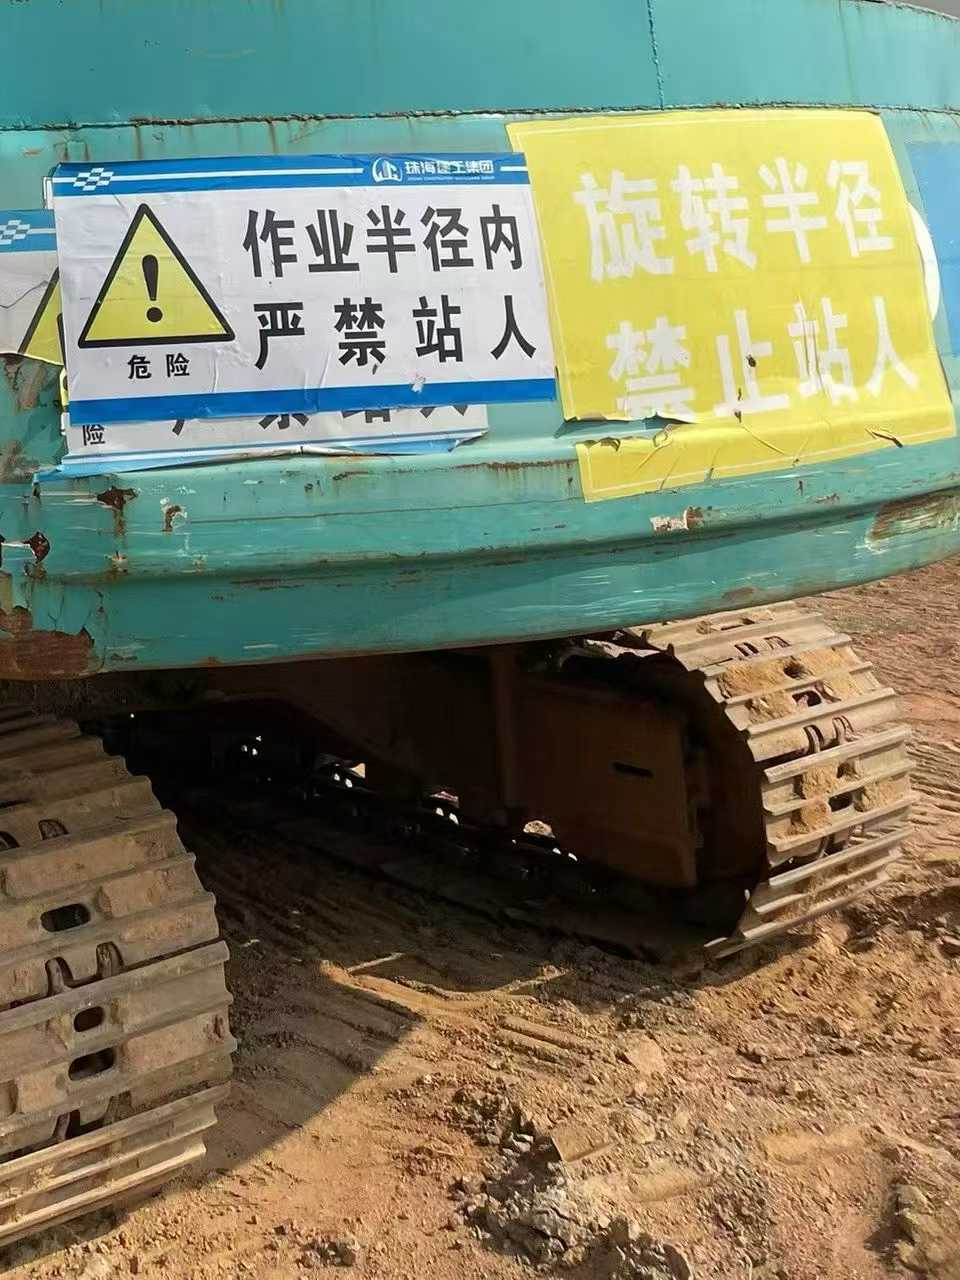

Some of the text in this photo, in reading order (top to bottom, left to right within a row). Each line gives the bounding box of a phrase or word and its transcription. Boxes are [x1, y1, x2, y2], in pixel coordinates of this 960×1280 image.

[243, 204, 523, 278] 作业半径内
[572, 156, 894, 282] 旋转半径
[127, 353, 191, 380] 危险
[253, 294, 537, 372] 严禁站人
[605, 295, 919, 419] 禁止站人
